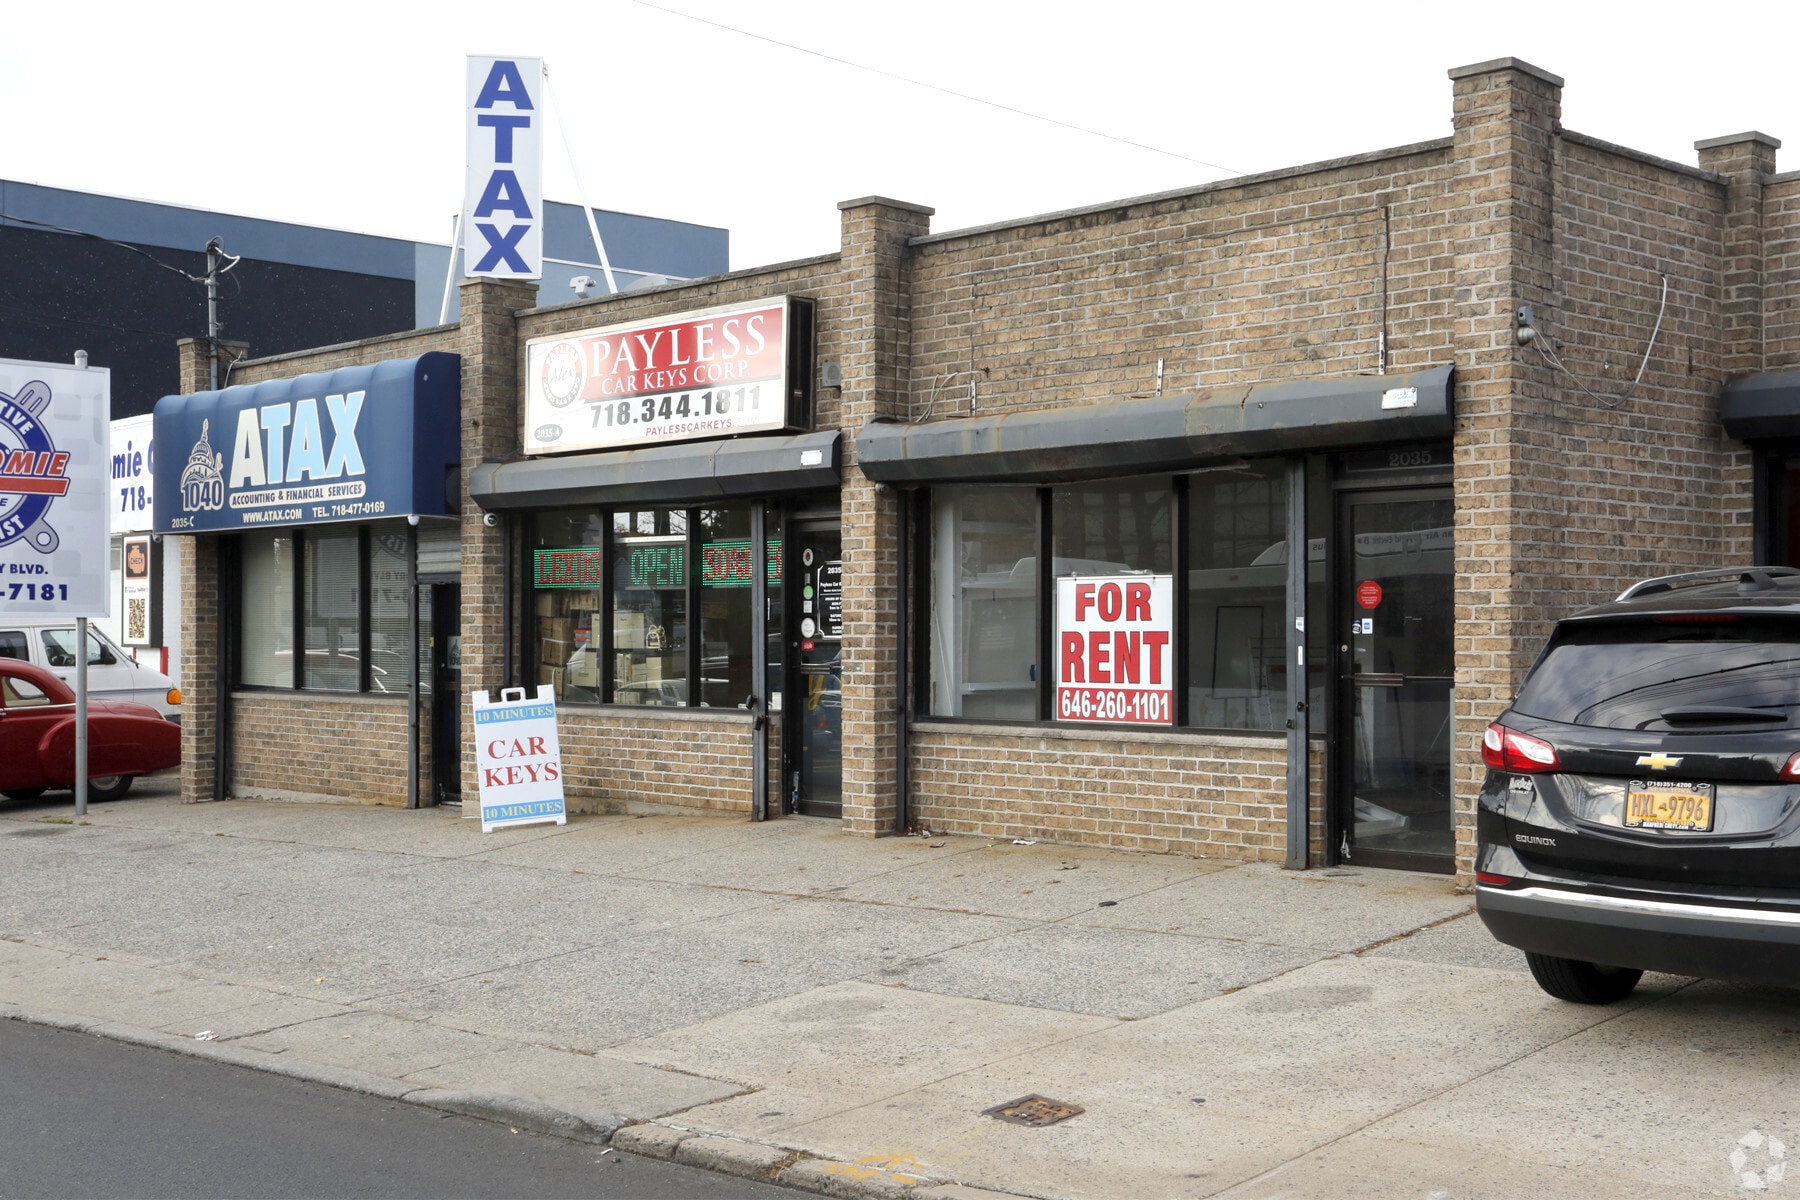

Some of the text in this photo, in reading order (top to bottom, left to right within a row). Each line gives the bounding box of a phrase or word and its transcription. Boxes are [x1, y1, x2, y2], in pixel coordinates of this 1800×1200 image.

[473, 60, 535, 273] ATAX
[591, 315, 766, 378] PAYLESS
[601, 360, 751, 395] CAR KEYS CORP.
[590, 385, 760, 428] 718.344.1811
[229, 389, 366, 489] ATAX
[536, 428, 560, 440] 2035-A
[110, 440, 142, 480] mie
[1388, 450, 1432, 467] 2035
[182, 479, 223, 511] 1040
[232, 484, 362, 506] ACCOUNTING & FINANCIAL SERVICES
[171, 515, 194, 529] 2035-C
[242, 501, 385, 524] WWW.ATAX.COM TEL. 718-477-0169
[10, 563, 49, 575] BLVD.
[538, 550, 600, 584] LEXUS
[631, 547, 683, 585] OPEN
[1075, 582, 1153, 622] FOR
[1061, 631, 1169, 684] RENT
[477, 705, 553, 722] 10 MINUTES
[1061, 689, 1169, 721] 646-260-1101
[488, 736, 547, 760] CAR
[483, 761, 559, 788] KEYS
[485, 801, 563, 819] 10 MINUTES
[1631, 794, 1704, 820] HXL 9796
[1515, 834, 1556, 846] EQUINOX
